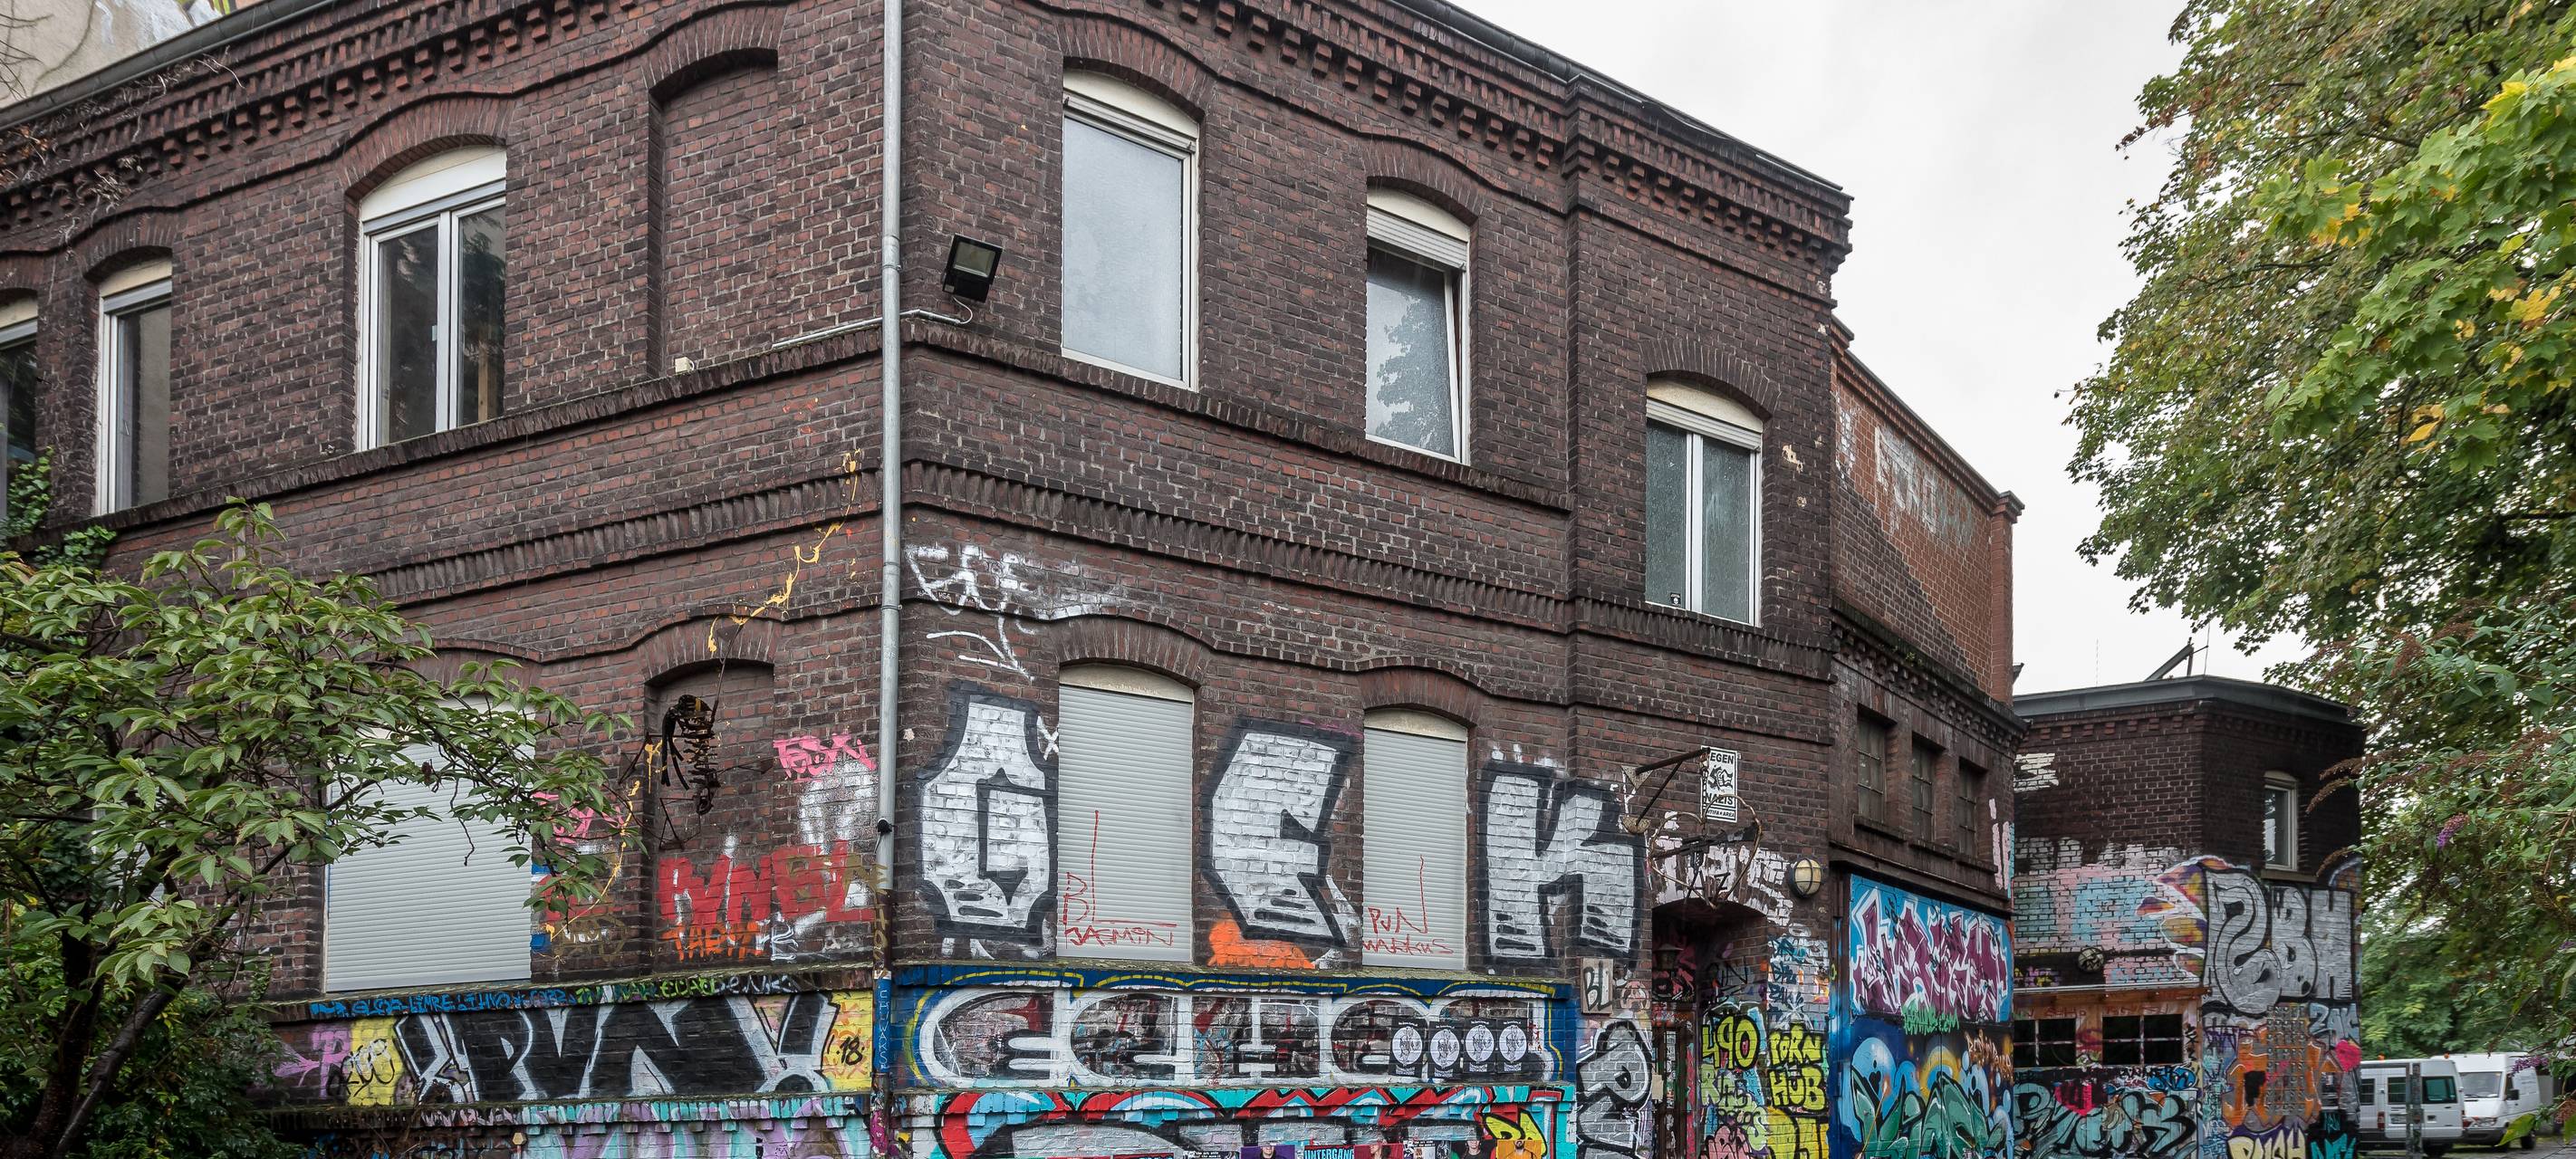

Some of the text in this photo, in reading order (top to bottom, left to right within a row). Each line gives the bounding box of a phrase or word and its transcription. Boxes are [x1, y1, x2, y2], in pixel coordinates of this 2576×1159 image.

[1706, 752, 1734, 764] EGEN
[1768, 1023, 1824, 1066] PORN
[1769, 1065, 1828, 1112] HUB
